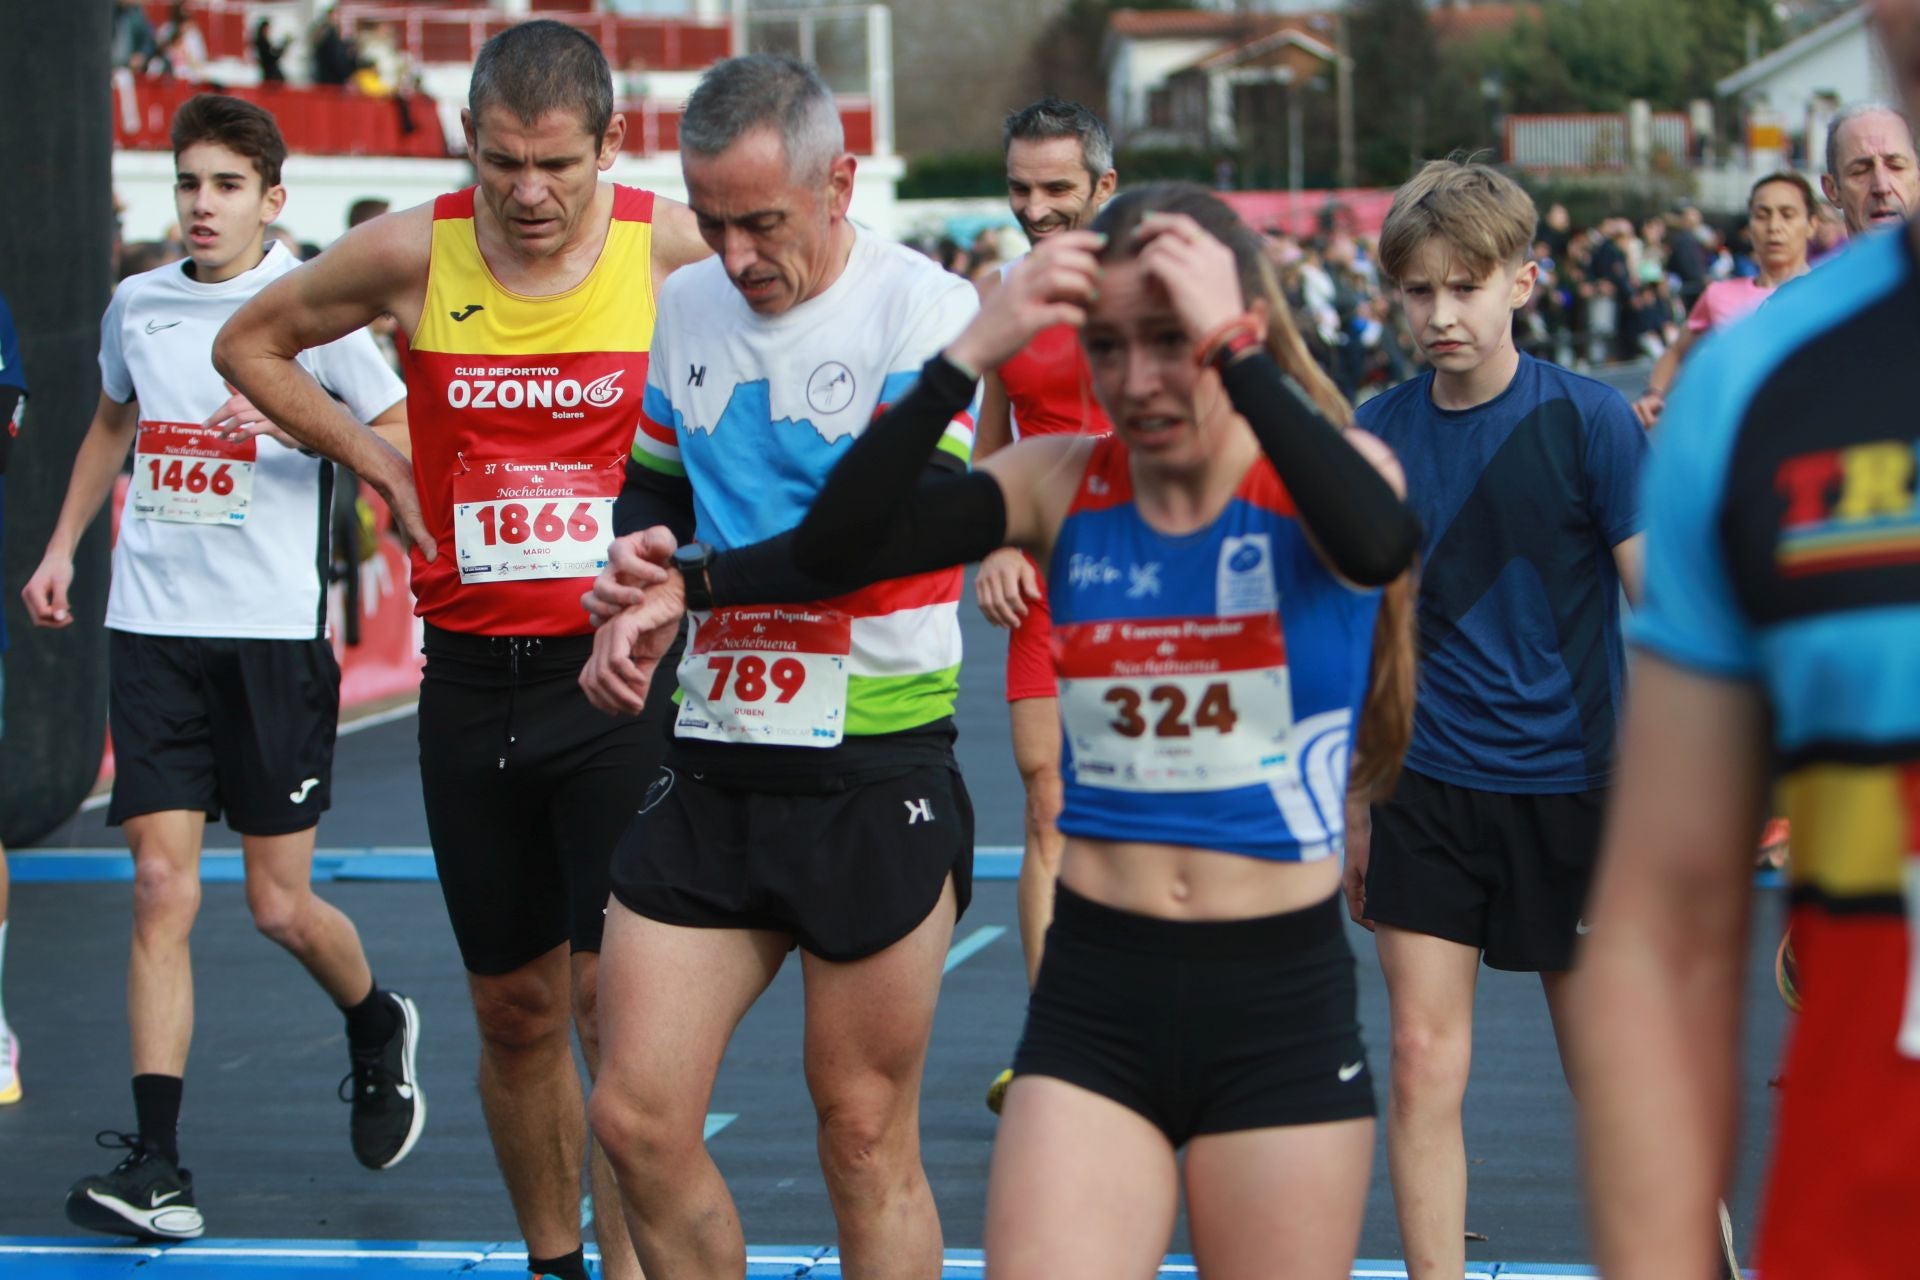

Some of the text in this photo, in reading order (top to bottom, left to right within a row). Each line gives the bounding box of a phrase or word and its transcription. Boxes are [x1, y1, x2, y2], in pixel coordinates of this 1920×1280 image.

[454, 367, 559, 376] CLUB DEPORTIVO
[447, 379, 582, 409] OZONO
[552, 411, 585, 419] Solares
[485, 463, 497, 475] 37
[549, 461, 593, 472] Popular
[148, 459, 234, 496] 1466
[531, 474, 544, 484] de
[496, 485, 575, 499] Nochebuena
[475, 502, 599, 546] 1866
[523, 548, 551, 556] MARIO
[734, 610, 771, 621] Carrera
[773, 608, 822, 623] Popular
[753, 623, 766, 634] de
[719, 636, 797, 651] Nochebuena
[707, 655, 806, 704] 789
[734, 707, 765, 717] RUBEN
[1103, 681, 1239, 738] 324
